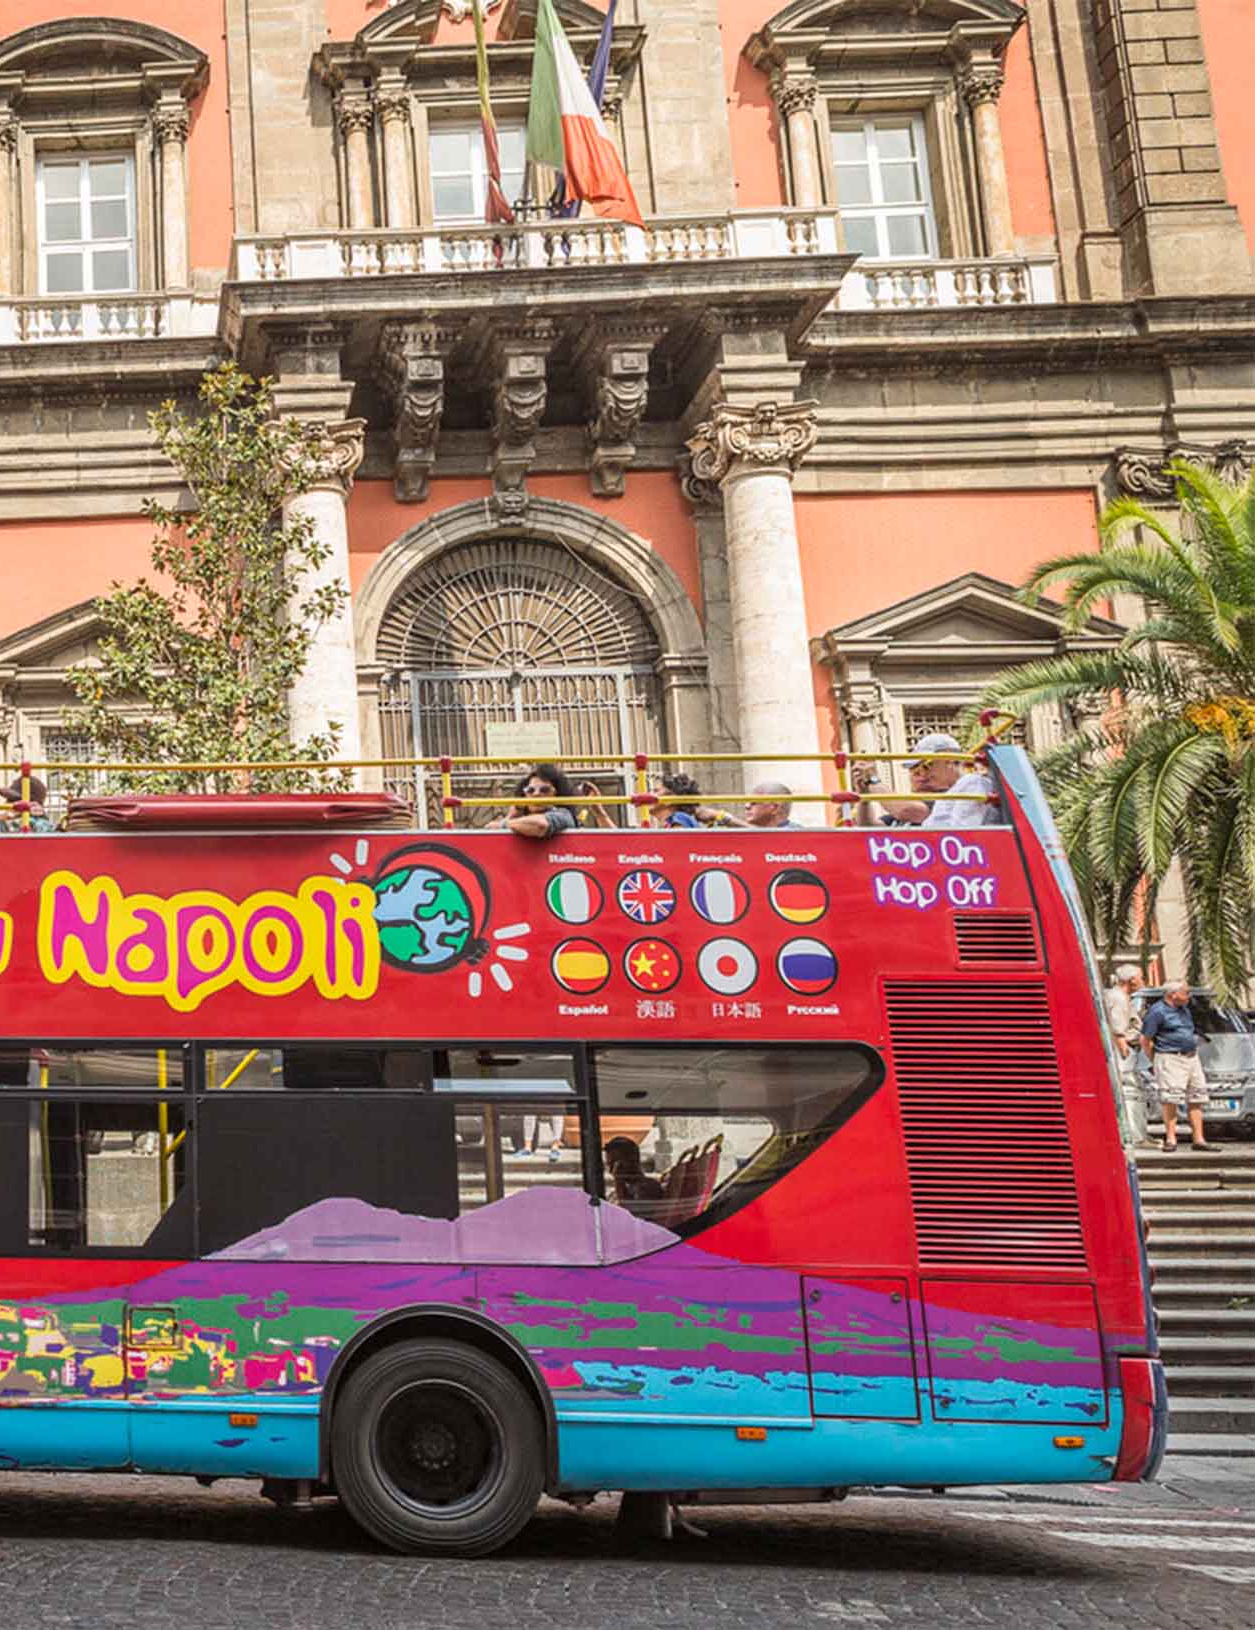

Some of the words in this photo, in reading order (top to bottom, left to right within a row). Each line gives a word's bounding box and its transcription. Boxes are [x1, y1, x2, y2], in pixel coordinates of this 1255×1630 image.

[764, 852, 818, 863] Deutsch
[867, 836, 932, 869] Hop
[940, 834, 985, 865] On
[547, 852, 596, 864] Italiano
[617, 853, 664, 865] English
[688, 852, 743, 864] Français
[874, 876, 938, 909] Hop
[946, 874, 995, 905] Off
[41, 873, 378, 1009] Napoli
[558, 1004, 609, 1016] Español
[711, 1000, 762, 1019] 日本語
